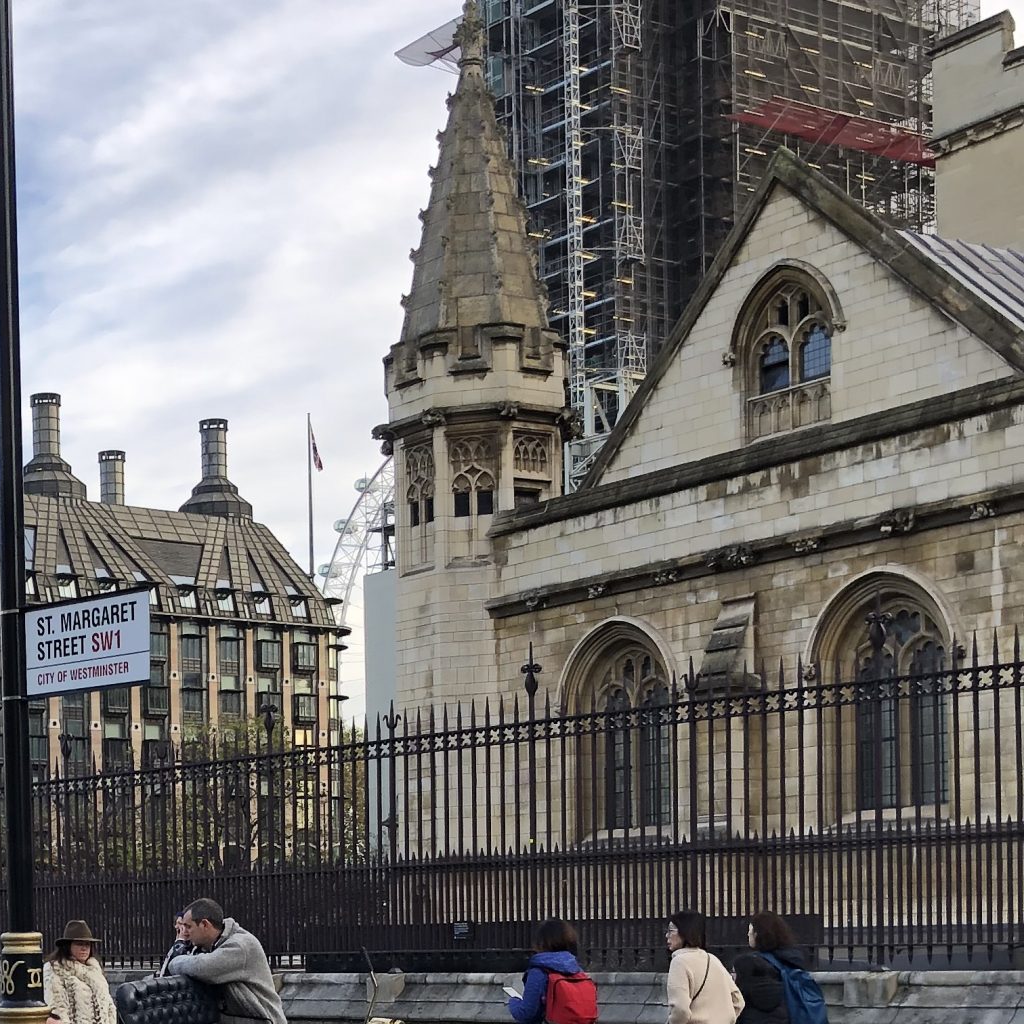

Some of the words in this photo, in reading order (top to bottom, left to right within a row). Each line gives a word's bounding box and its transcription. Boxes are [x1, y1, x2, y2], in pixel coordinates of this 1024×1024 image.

[37, 616, 55, 636] ST.
[61, 601, 137, 633] MARGARET
[37, 635, 86, 661] STREET
[91, 630, 121, 653] SW1
[38, 672, 55, 686] CITY
[57, 671, 68, 683] OF
[70, 661, 129, 681] WESTMINSTER
